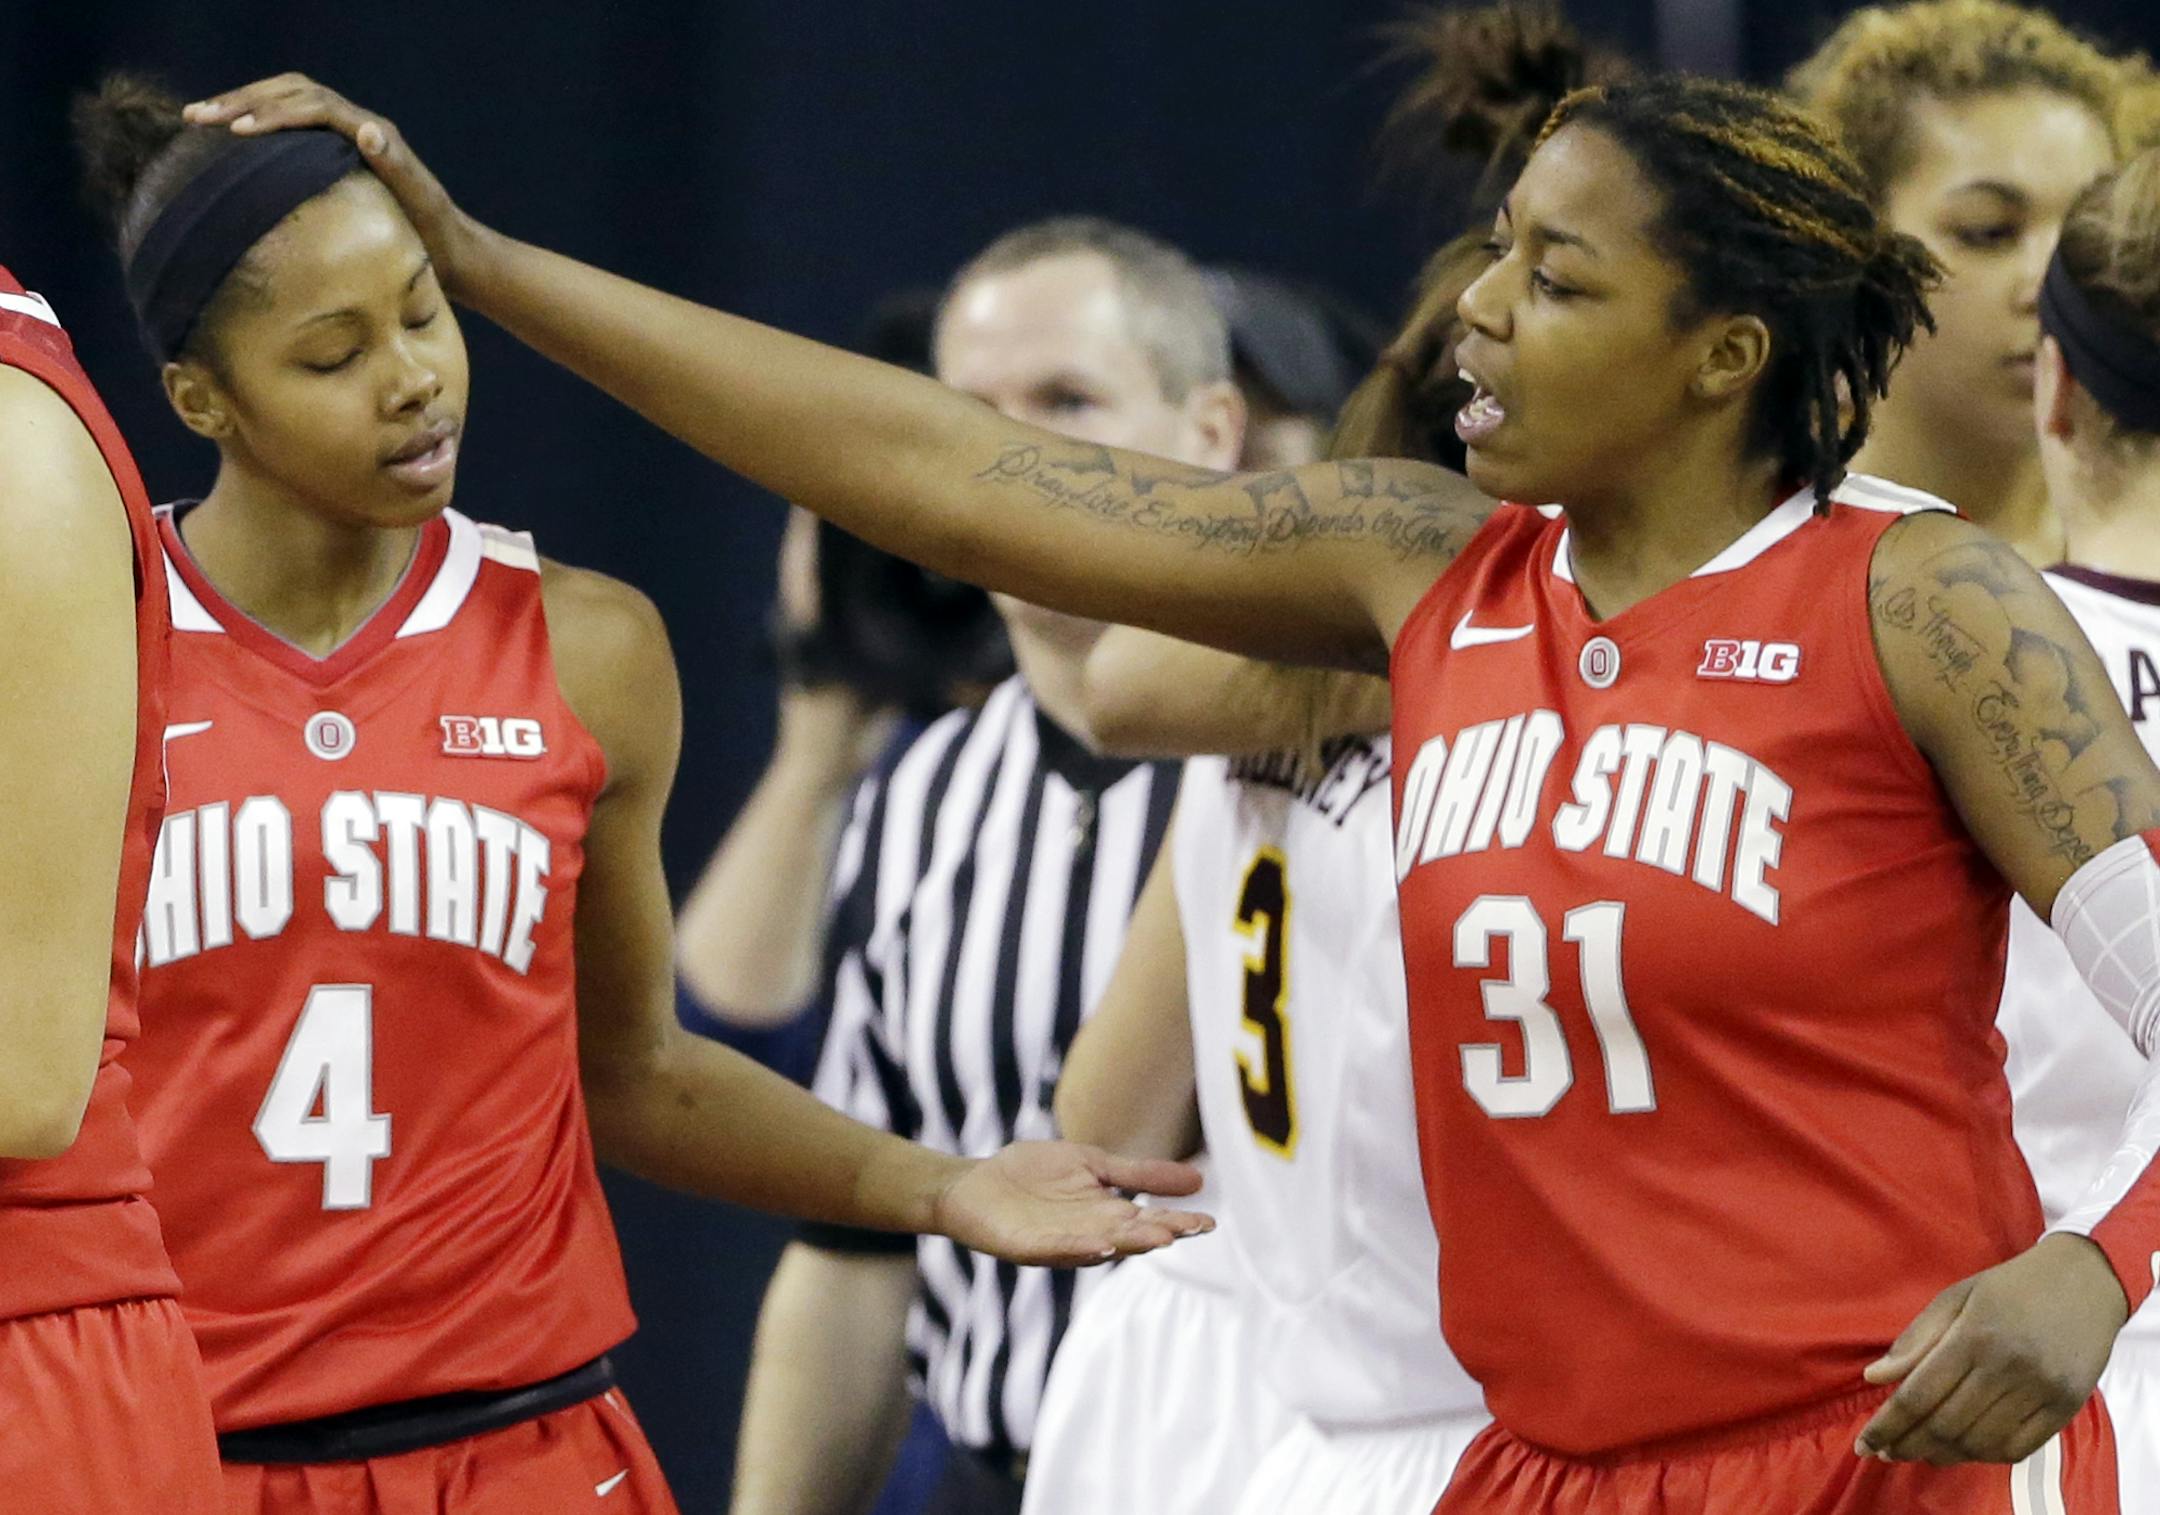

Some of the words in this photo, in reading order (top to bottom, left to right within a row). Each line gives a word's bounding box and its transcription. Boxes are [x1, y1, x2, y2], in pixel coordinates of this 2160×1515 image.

[134, 794, 294, 968] HIO
[321, 790, 551, 977] STATE
[1396, 708, 1566, 886] OHIO
[1552, 722, 1794, 927] STATE
[252, 983, 392, 1211] 4
[1233, 843, 1297, 1164] 3
[1453, 894, 1658, 1119] 31
